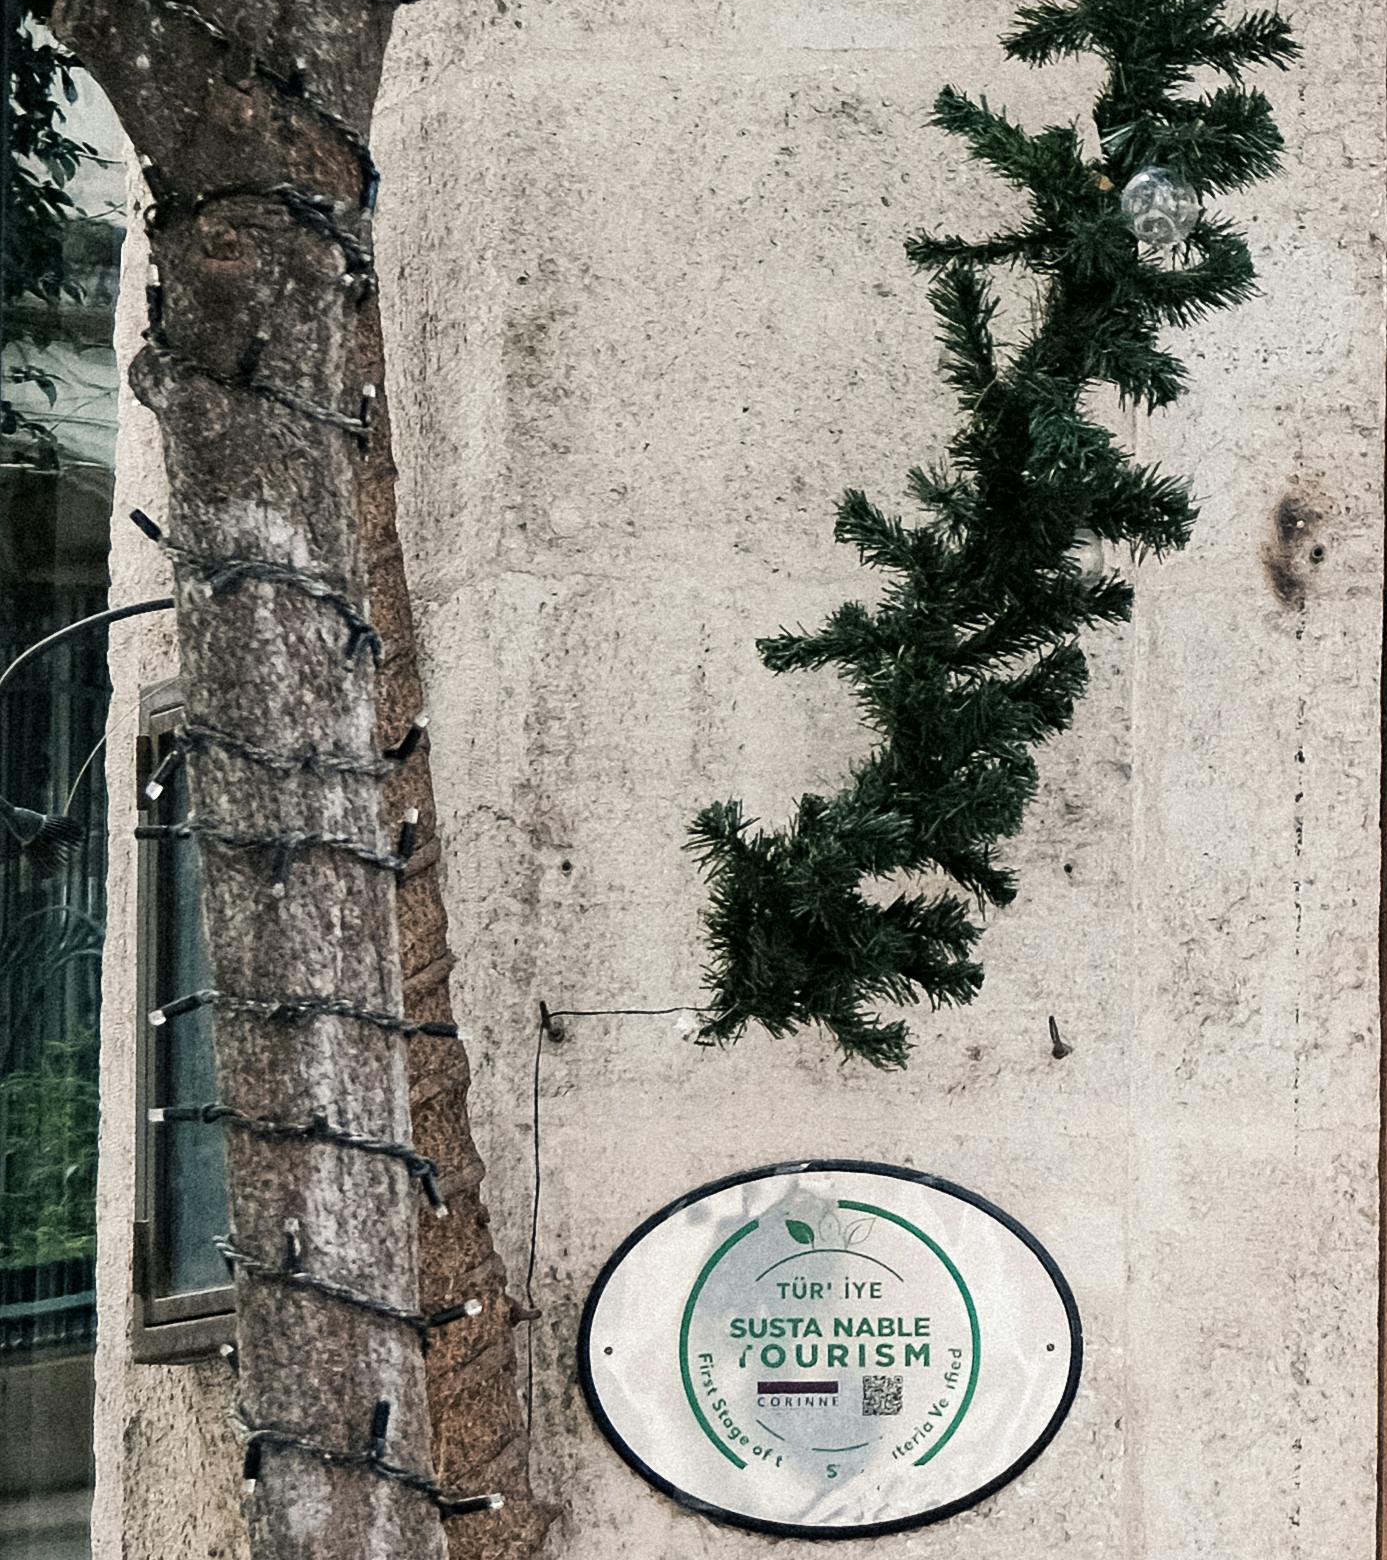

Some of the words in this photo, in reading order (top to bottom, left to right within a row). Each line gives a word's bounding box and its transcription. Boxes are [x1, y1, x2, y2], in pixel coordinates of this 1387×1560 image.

[776, 1276, 882, 1300] TÜRİYE
[730, 1317, 931, 1338] SUSTANABLE
[698, 1353, 718, 1396] First
[711, 1398, 750, 1446] Stage
[752, 1445, 774, 1461] of
[757, 1397, 839, 1407] CORINNE
